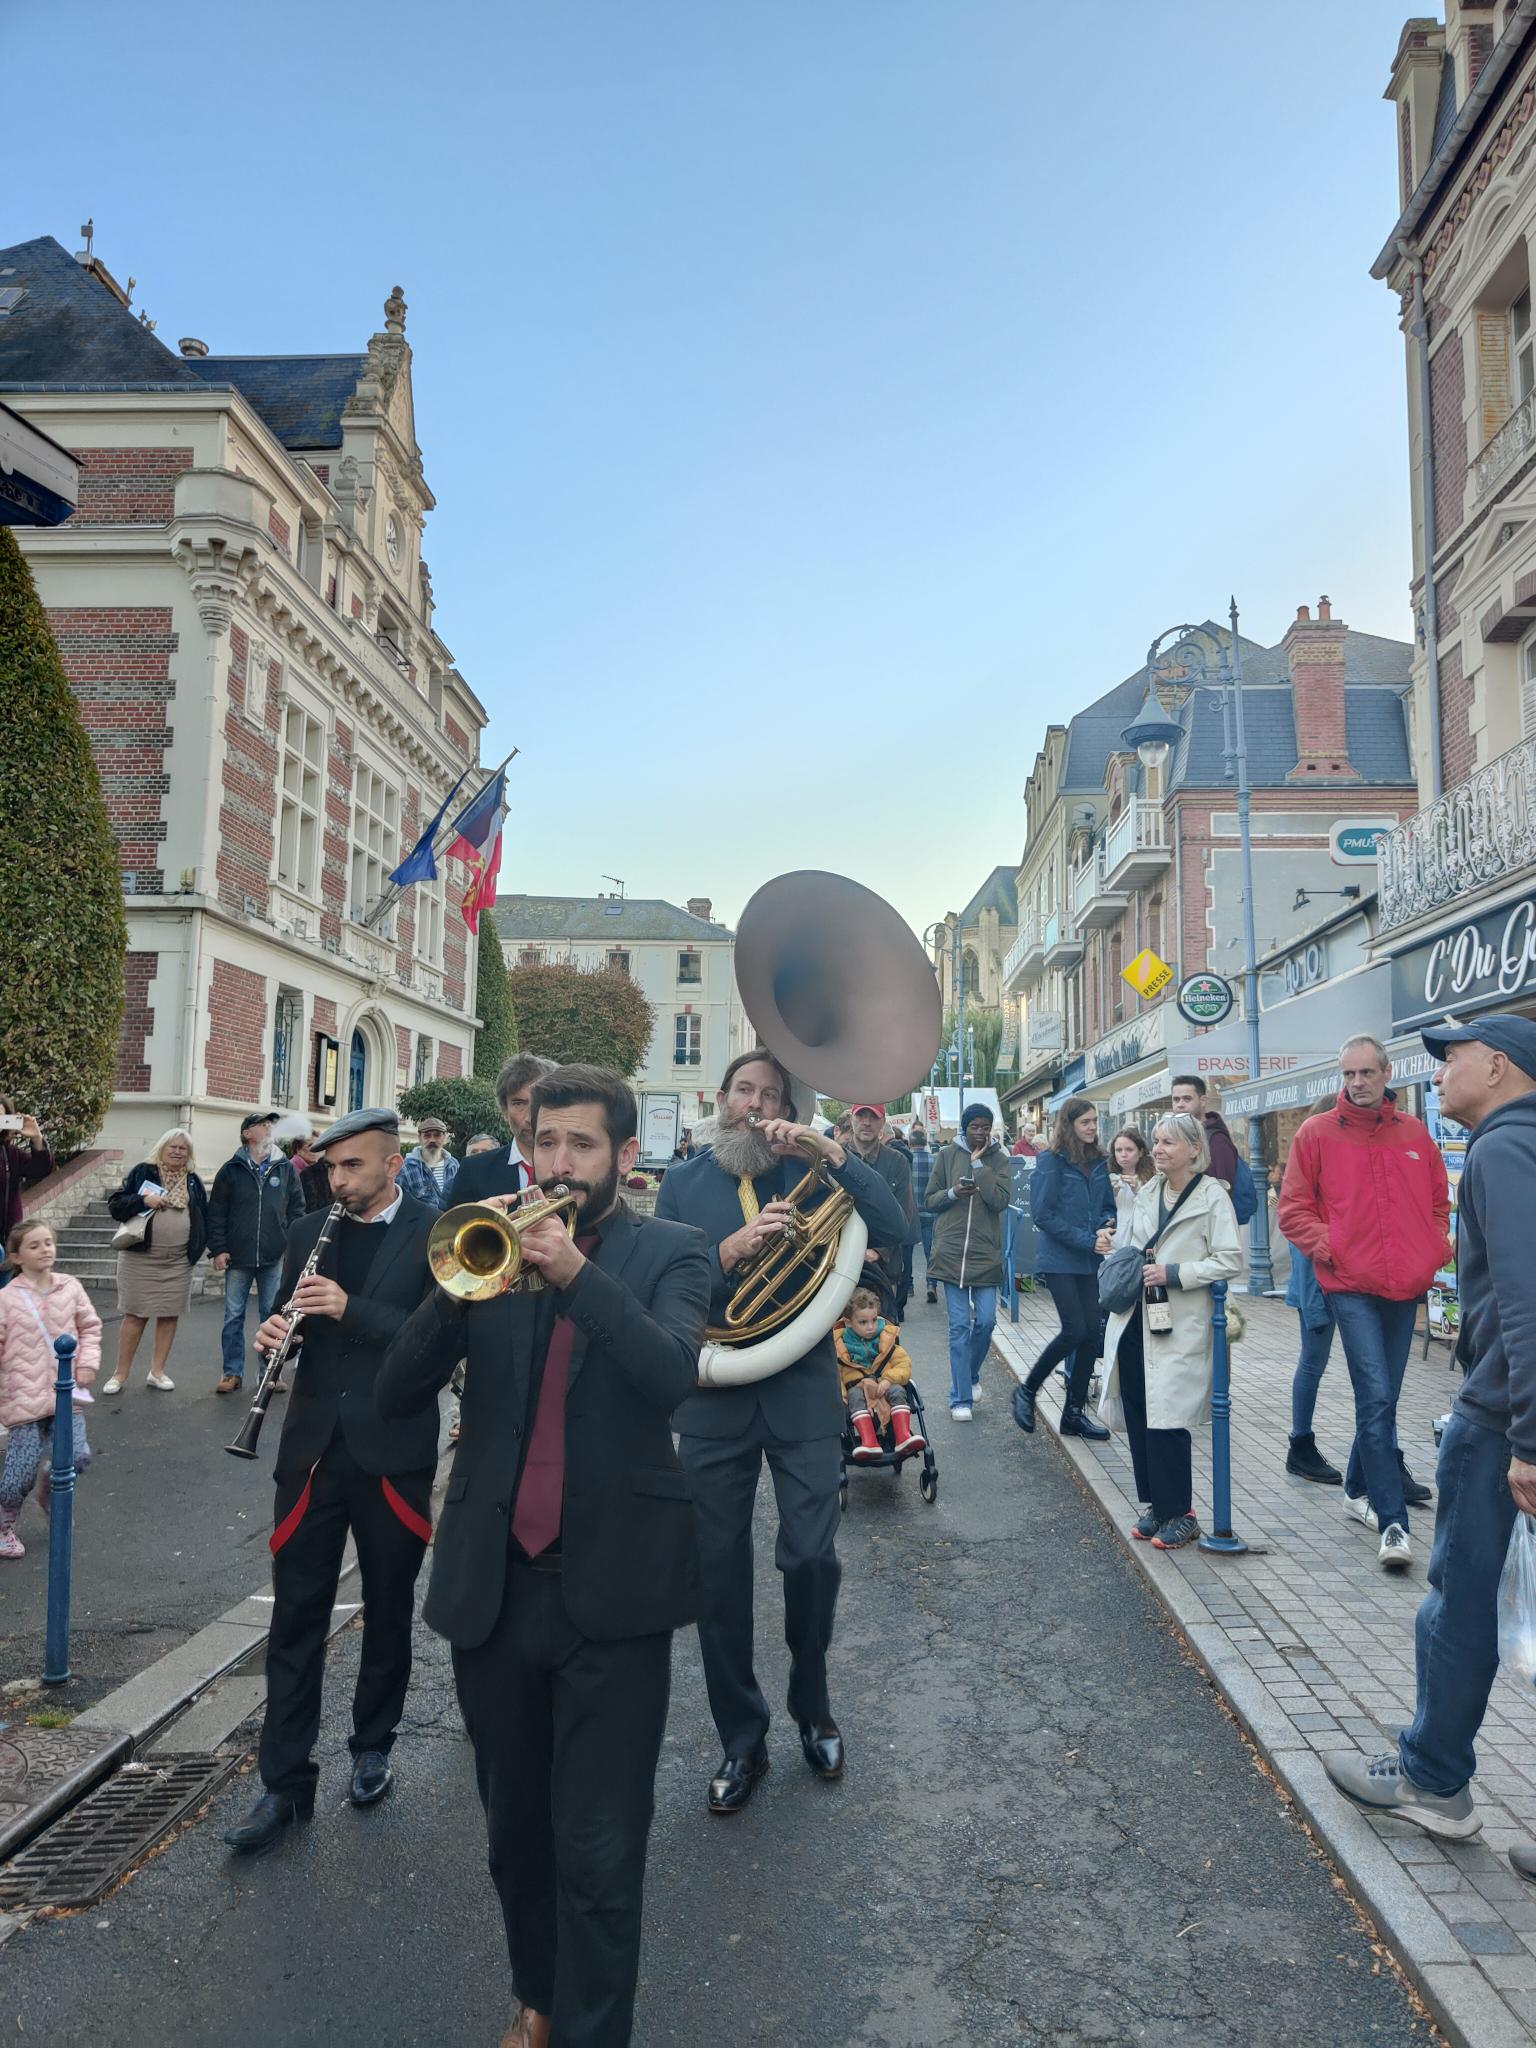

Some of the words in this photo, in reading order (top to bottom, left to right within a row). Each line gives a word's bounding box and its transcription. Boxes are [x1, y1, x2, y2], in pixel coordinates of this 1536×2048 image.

[1342, 838, 1371, 848] PMU
[1143, 969, 1171, 997] PRESSE
[1184, 993, 1227, 1003] Heineken
